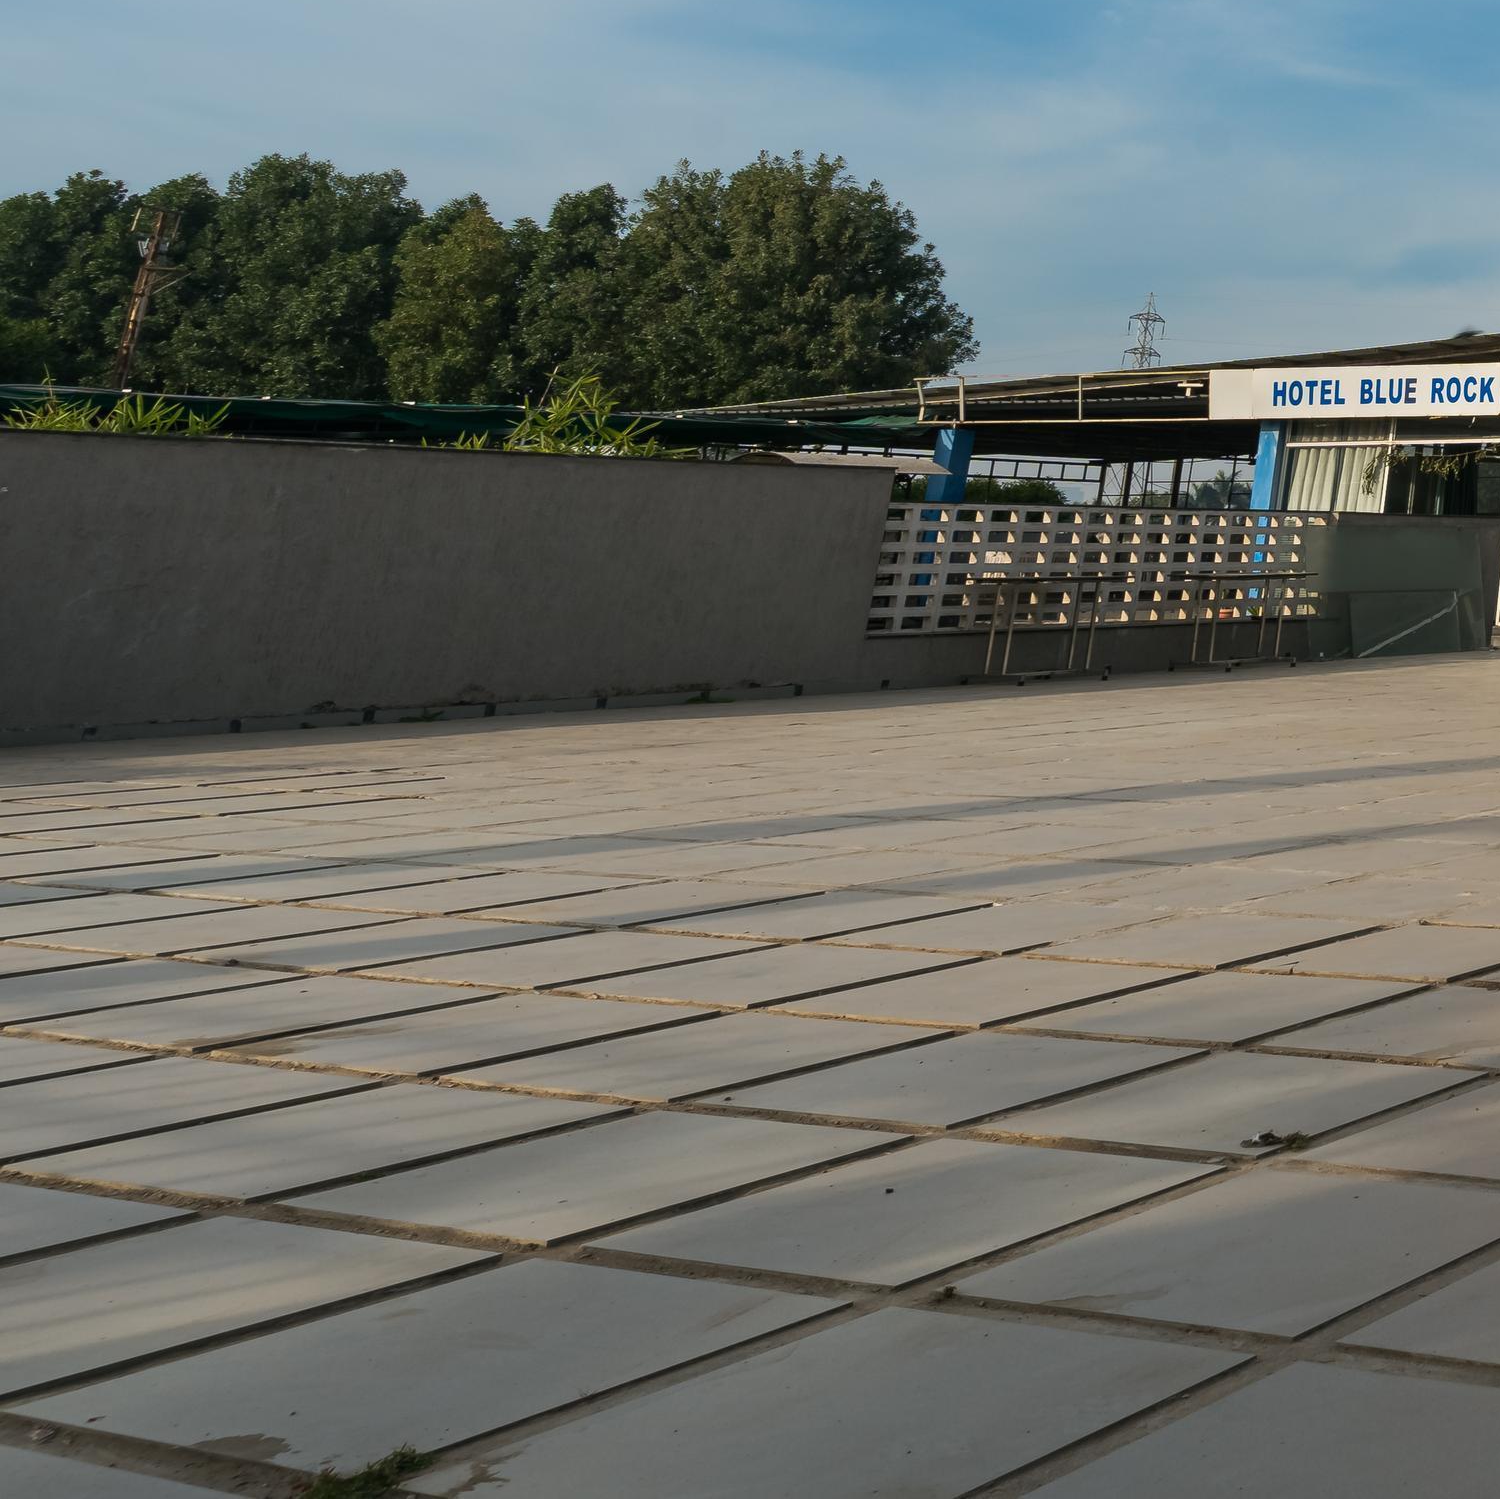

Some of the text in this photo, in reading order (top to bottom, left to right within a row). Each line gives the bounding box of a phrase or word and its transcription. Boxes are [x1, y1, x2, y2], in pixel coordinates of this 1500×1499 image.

[1272, 376, 1496, 406] HOTEL BLUE ROCK
